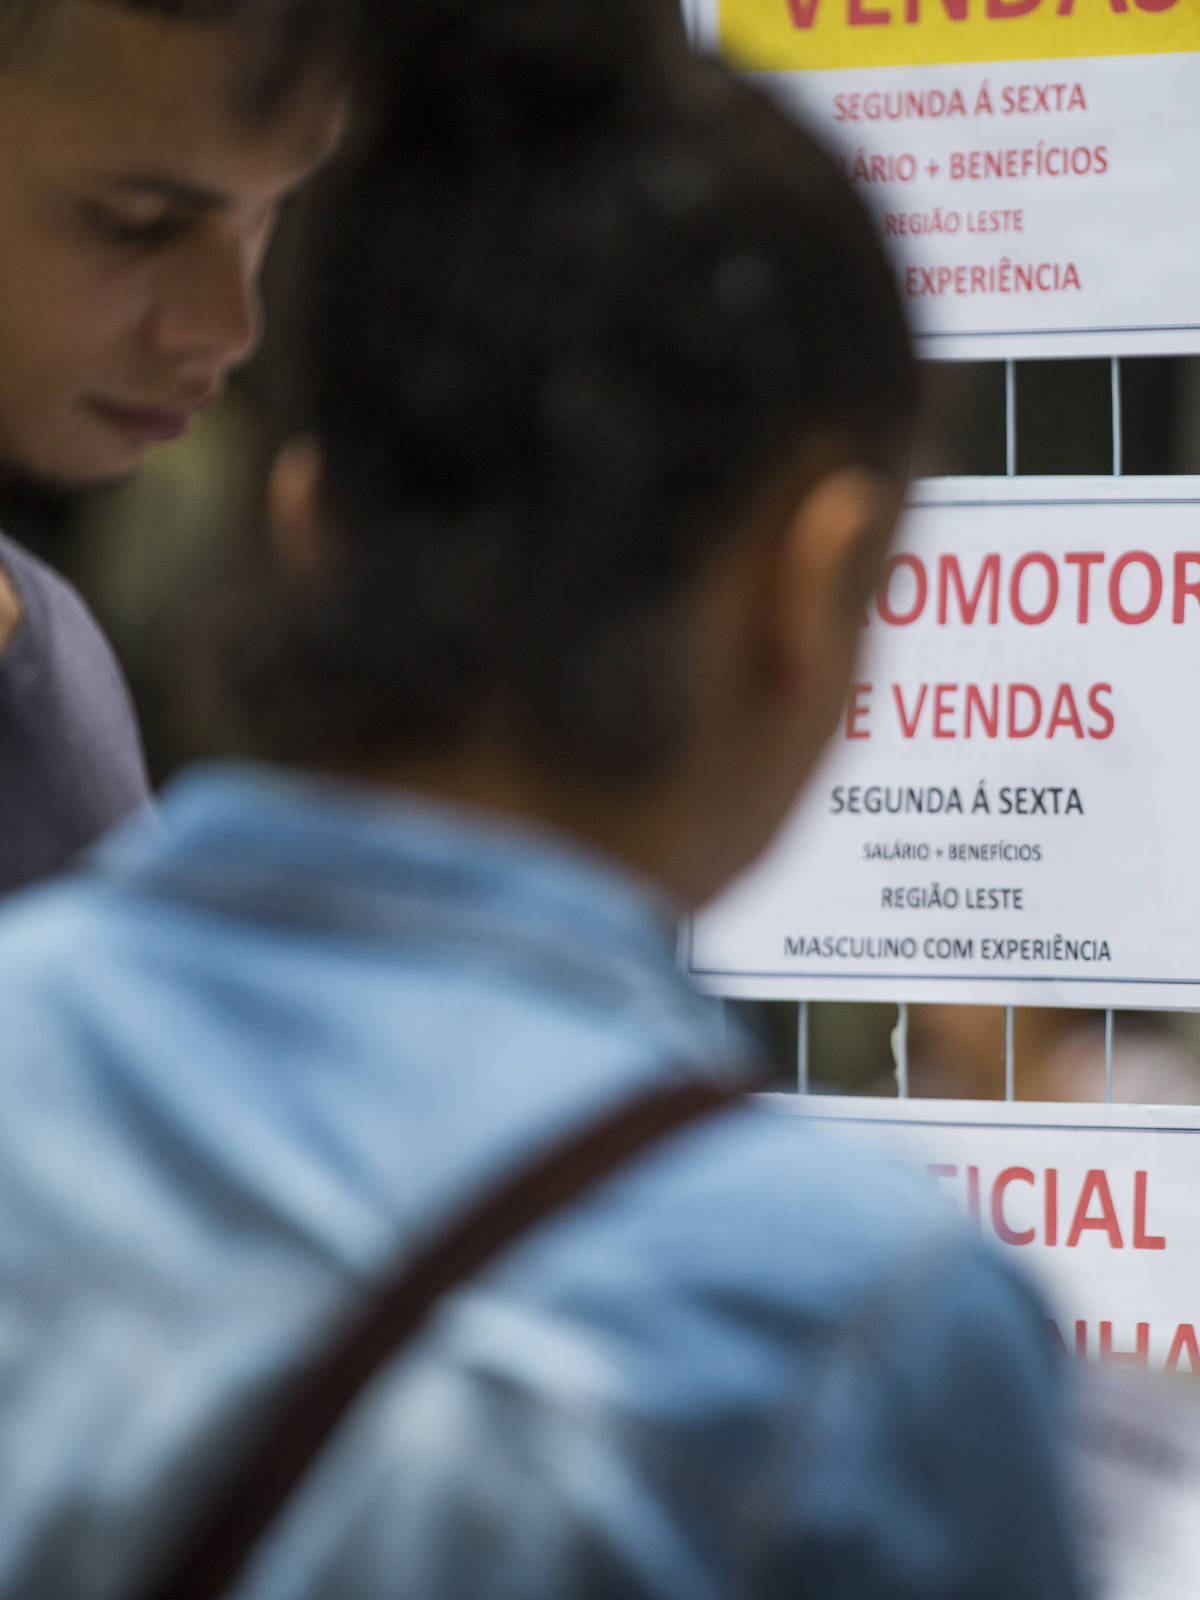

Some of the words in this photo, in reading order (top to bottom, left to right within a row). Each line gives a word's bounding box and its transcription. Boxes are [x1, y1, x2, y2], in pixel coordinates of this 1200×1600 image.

[834, 88, 967, 122] SEGUNDA
[974, 83, 994, 115] Á
[1001, 83, 1087, 116] SEXTA
[926, 161, 940, 177] +
[949, 145, 1109, 181] BENEFÍCIOS
[886, 207, 961, 237] REGIÃO
[967, 208, 1023, 233] LESTE
[906, 256, 1081, 296] EXPERIÊNCIA
[845, 682, 872, 740] E
[892, 682, 1115, 740] VENDAS
[829, 786, 963, 814] SEGUNDA
[971, 780, 990, 814] Á
[999, 787, 1084, 815] SEXTA
[863, 842, 930, 861] SALÁRIO
[948, 843, 1042, 862] BENEFÍCIOS
[881, 886, 958, 909] REGIÃO
[965, 887, 1023, 911] LESTE
[784, 936, 918, 959] MASCULINO
[923, 937, 974, 960] COM
[981, 933, 1111, 962] EXPERIÊNCIA
[927, 1163, 1166, 1250] ICIAL
